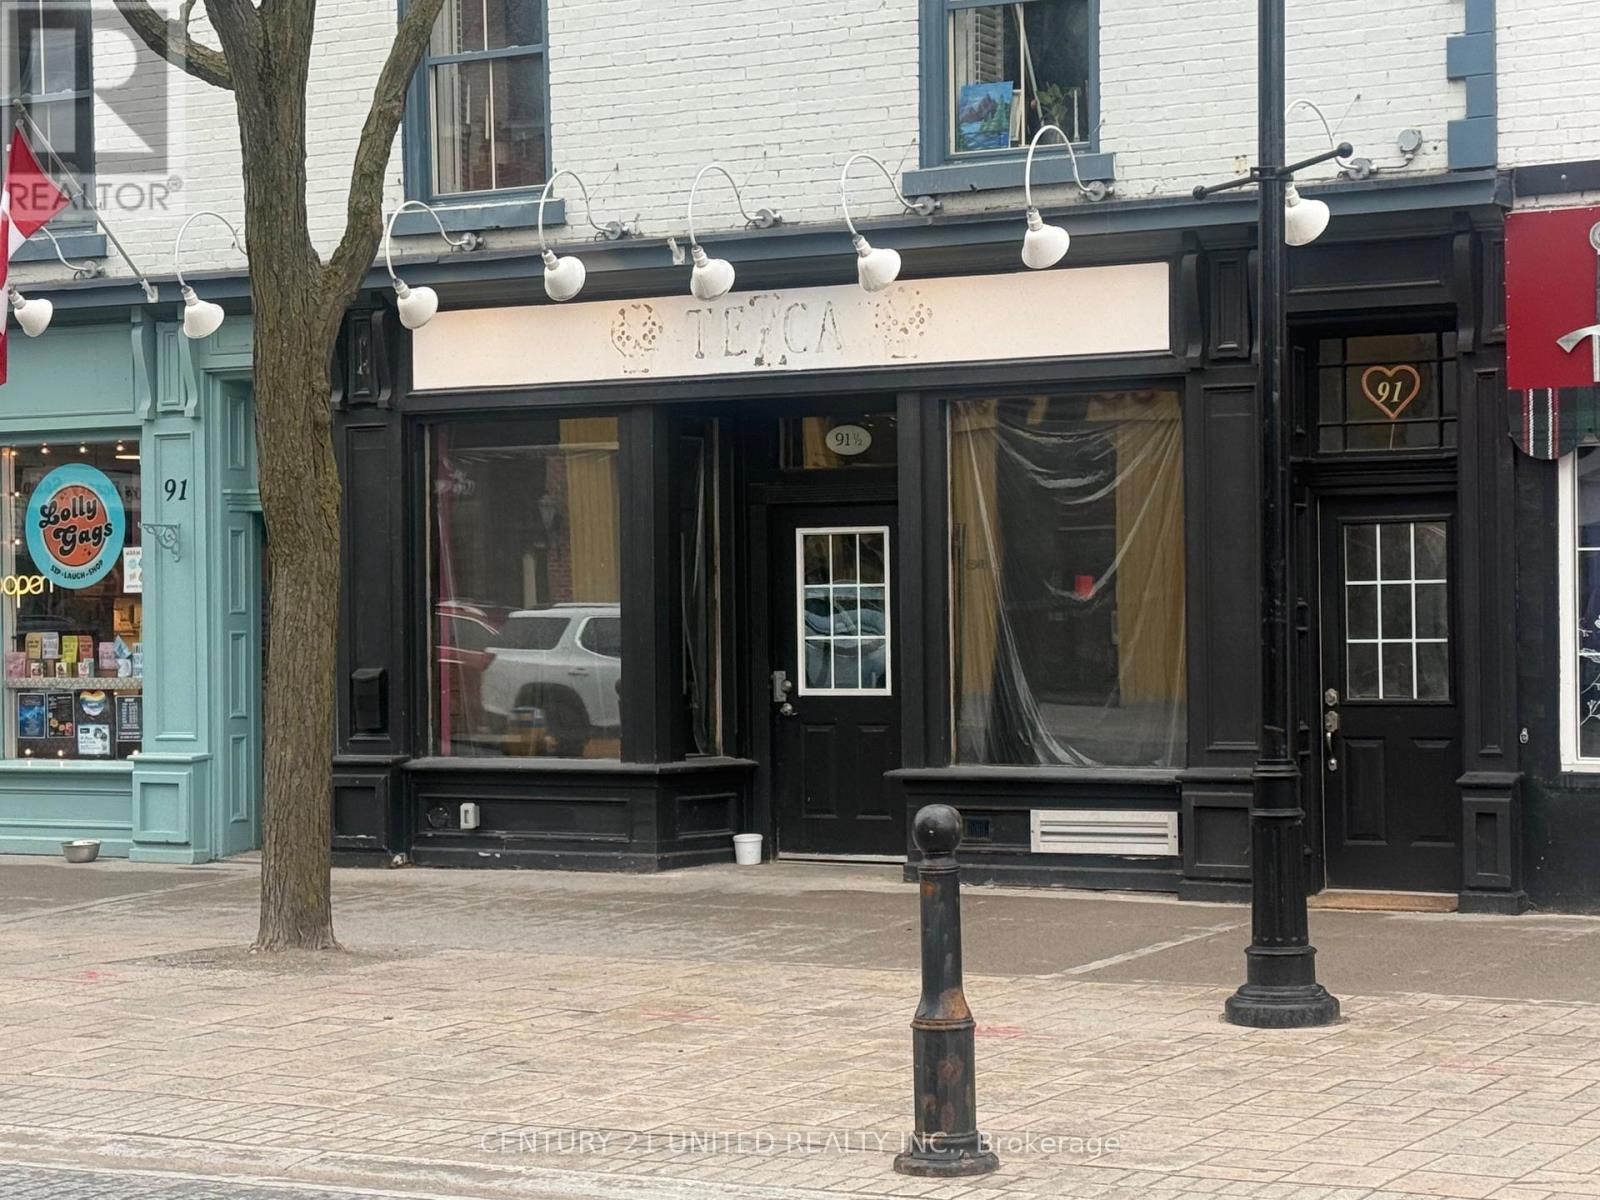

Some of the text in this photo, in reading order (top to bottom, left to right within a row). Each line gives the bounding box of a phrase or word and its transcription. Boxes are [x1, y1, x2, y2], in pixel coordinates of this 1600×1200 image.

[1376, 381, 1403, 403] 91
[165, 478, 188, 502] 91
[39, 495, 97, 529] Lolly
[53, 522, 113, 556] Gags
[4, 575, 54, 609] open
